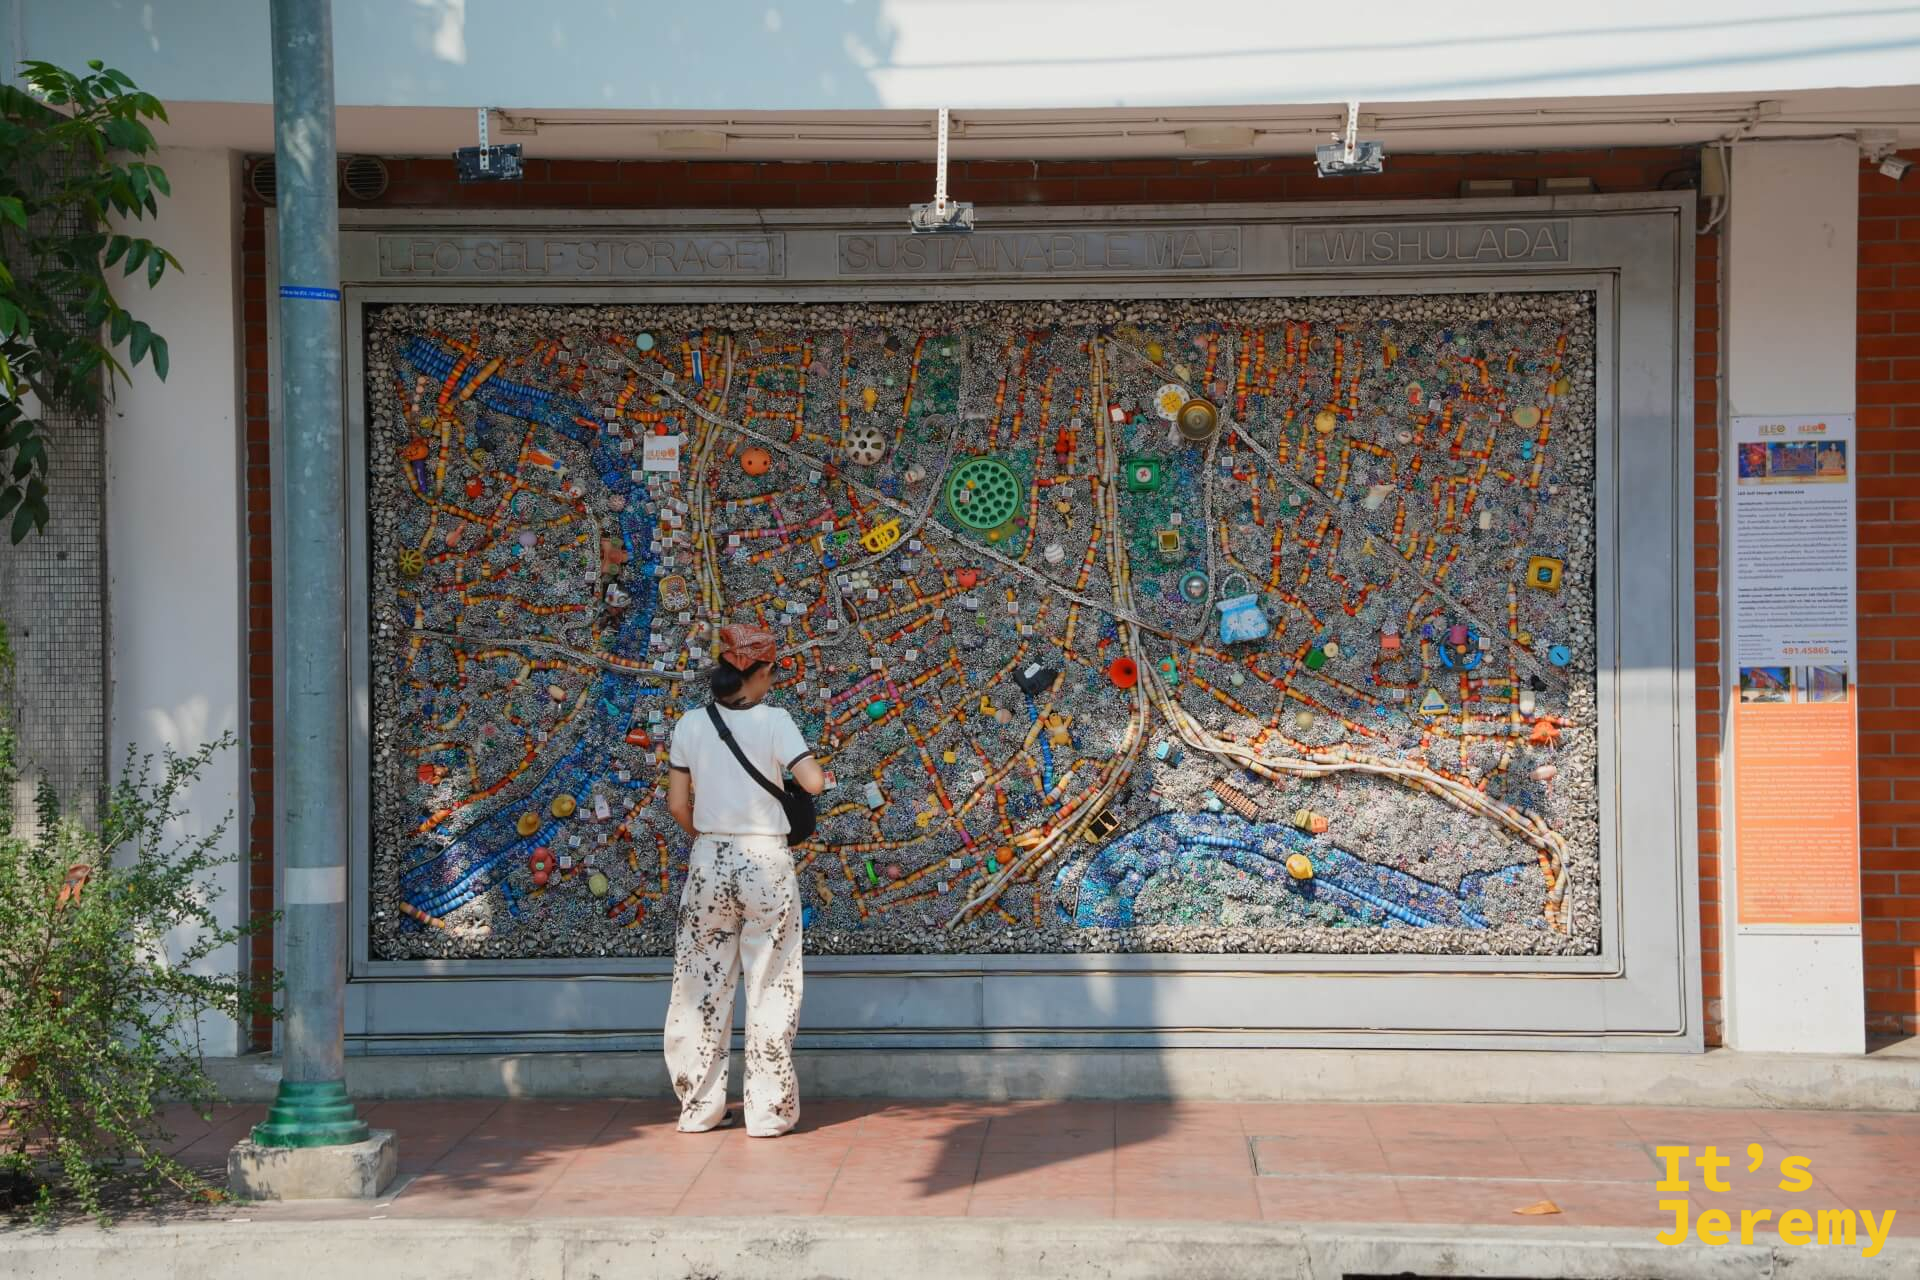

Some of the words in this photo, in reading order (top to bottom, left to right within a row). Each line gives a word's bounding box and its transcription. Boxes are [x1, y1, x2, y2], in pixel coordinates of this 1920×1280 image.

[387, 240, 462, 273] LEO
[846, 235, 1130, 271] SUSTAINABLE
[1144, 231, 1234, 269] MAP
[1320, 226, 1561, 264] WISHULADA
